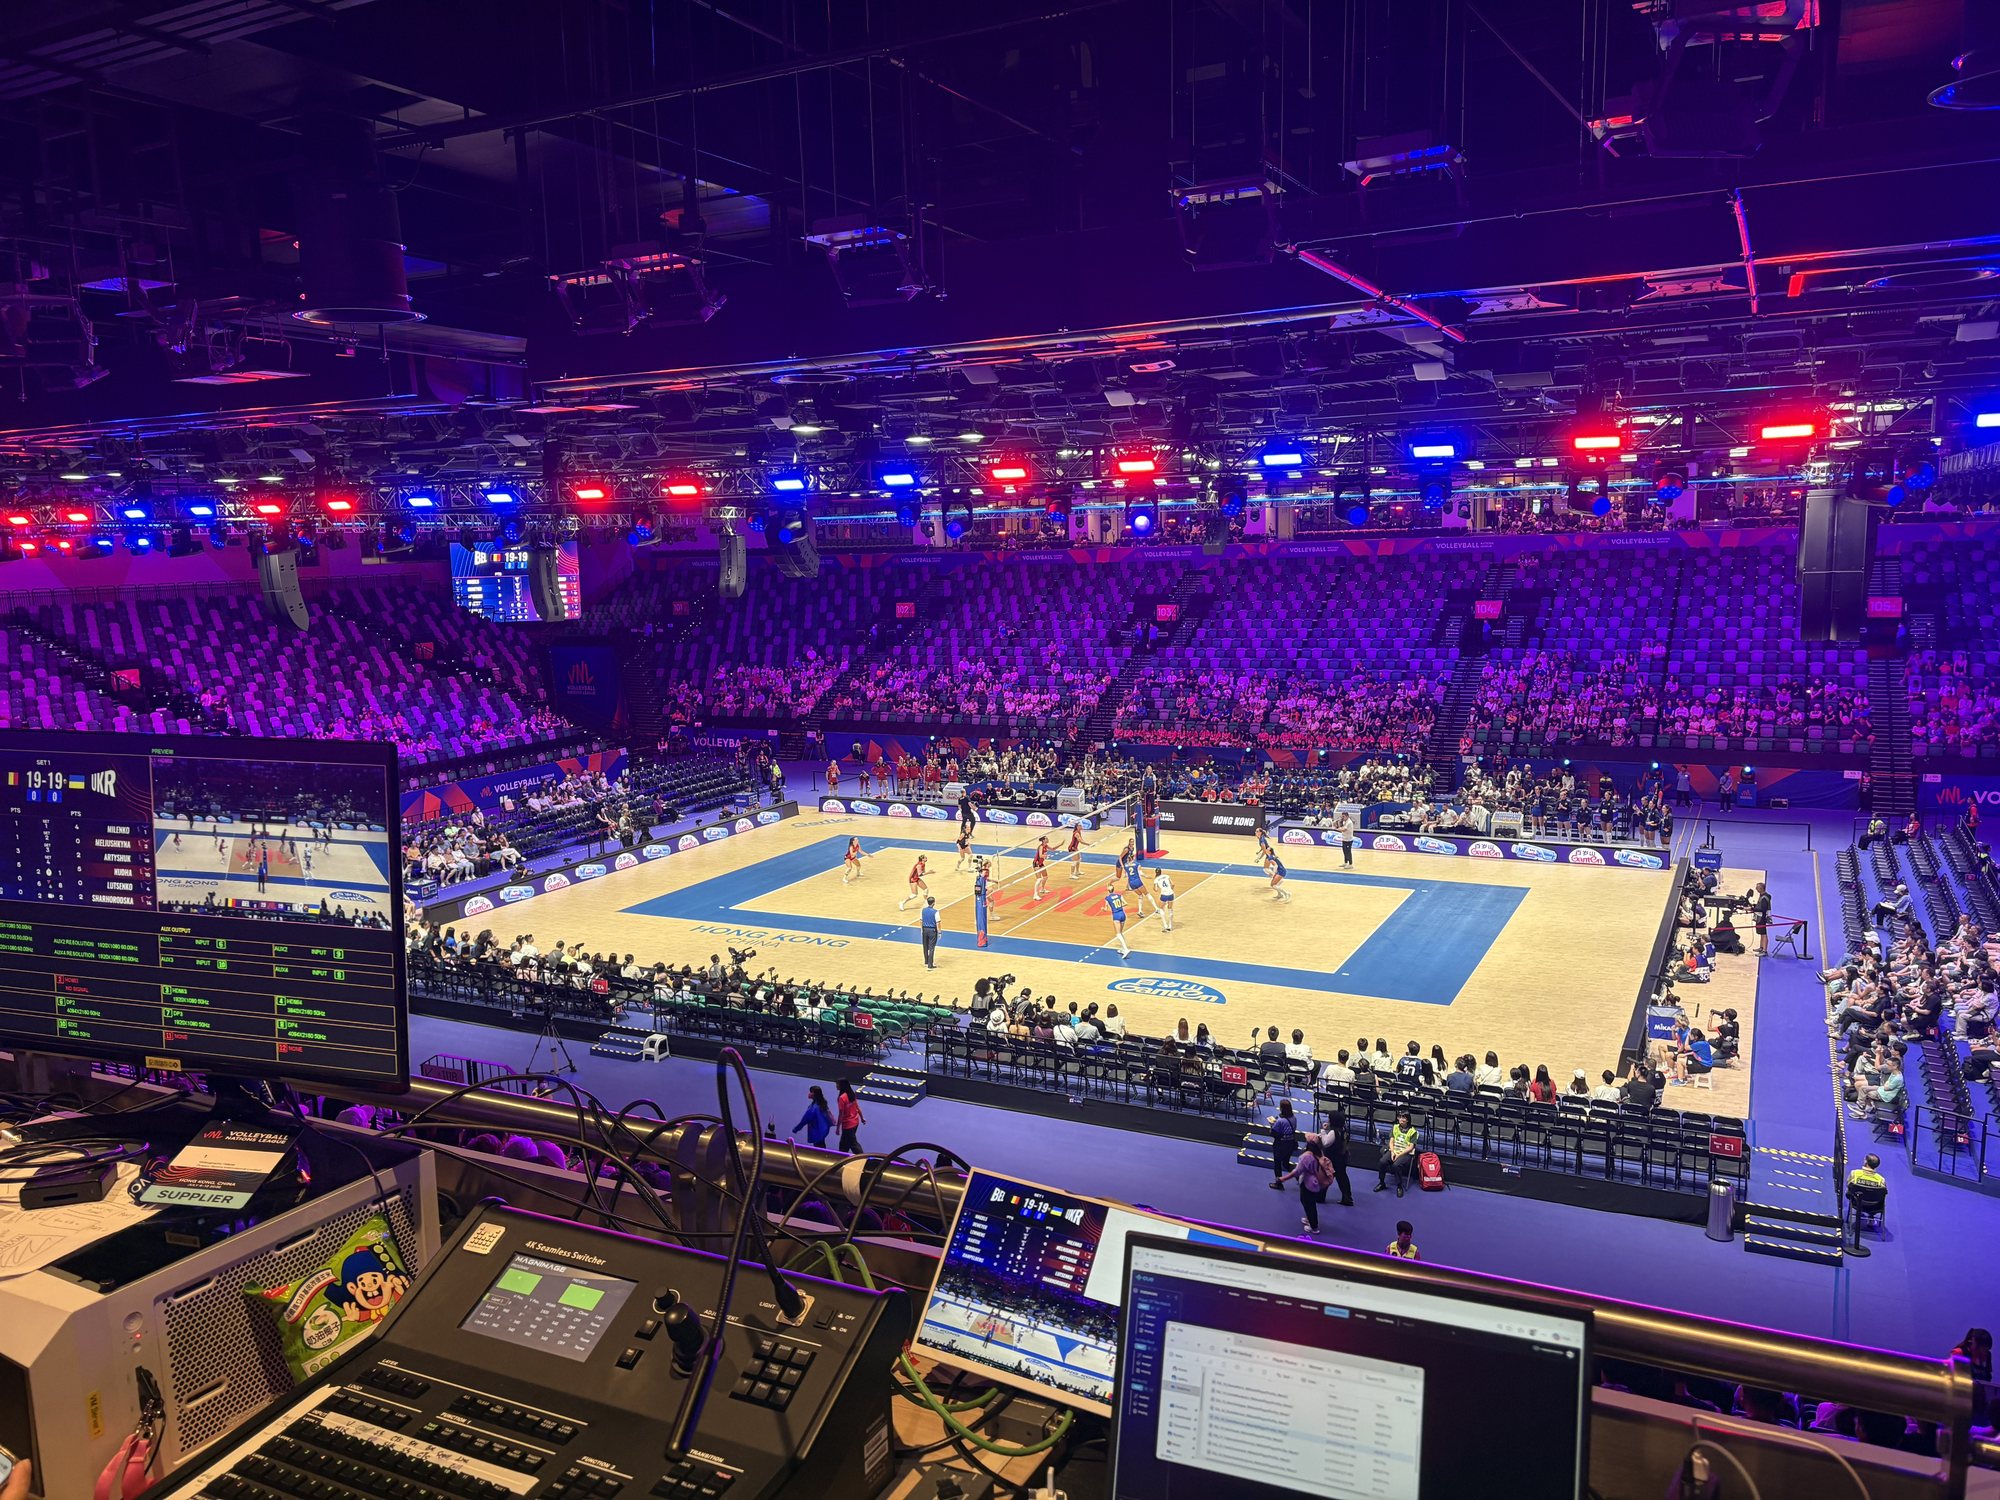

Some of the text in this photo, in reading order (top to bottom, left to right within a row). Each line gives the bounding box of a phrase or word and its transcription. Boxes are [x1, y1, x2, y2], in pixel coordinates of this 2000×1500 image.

[1476, 604, 1494, 614] 104
[90, 769, 117, 798] UKR
[494, 776, 540, 793] VOLLEYBALL
[1212, 816, 1255, 827] HONG KONG
[107, 826, 130, 834] MILENKO
[1128, 866, 1135, 876] 2
[106, 882, 133, 891] LUTSENKO
[1112, 898, 1122, 908] 10
[690, 925, 850, 948] HONG KONG
[726, 938, 780, 948] CHINA
[229, 1130, 288, 1140] VOLLEYBALL
[157, 1189, 234, 1204] SUPPLIER
[990, 1186, 1006, 1202] BEL
[1064, 1208, 1084, 1226] UKR
[525, 1240, 607, 1266] 4K Seamless Switcher
[514, 1256, 567, 1273] MAGNIMAGE
[759, 1301, 776, 1310] LIGHT
[704, 1309, 740, 1322] ADJUENT
[382, 1358, 399, 1366] LAYER
[440, 1412, 467, 1423] FUNCTION
[689, 1448, 724, 1463] TRANSITION
[581, 1456, 610, 1468] FUNCTION
